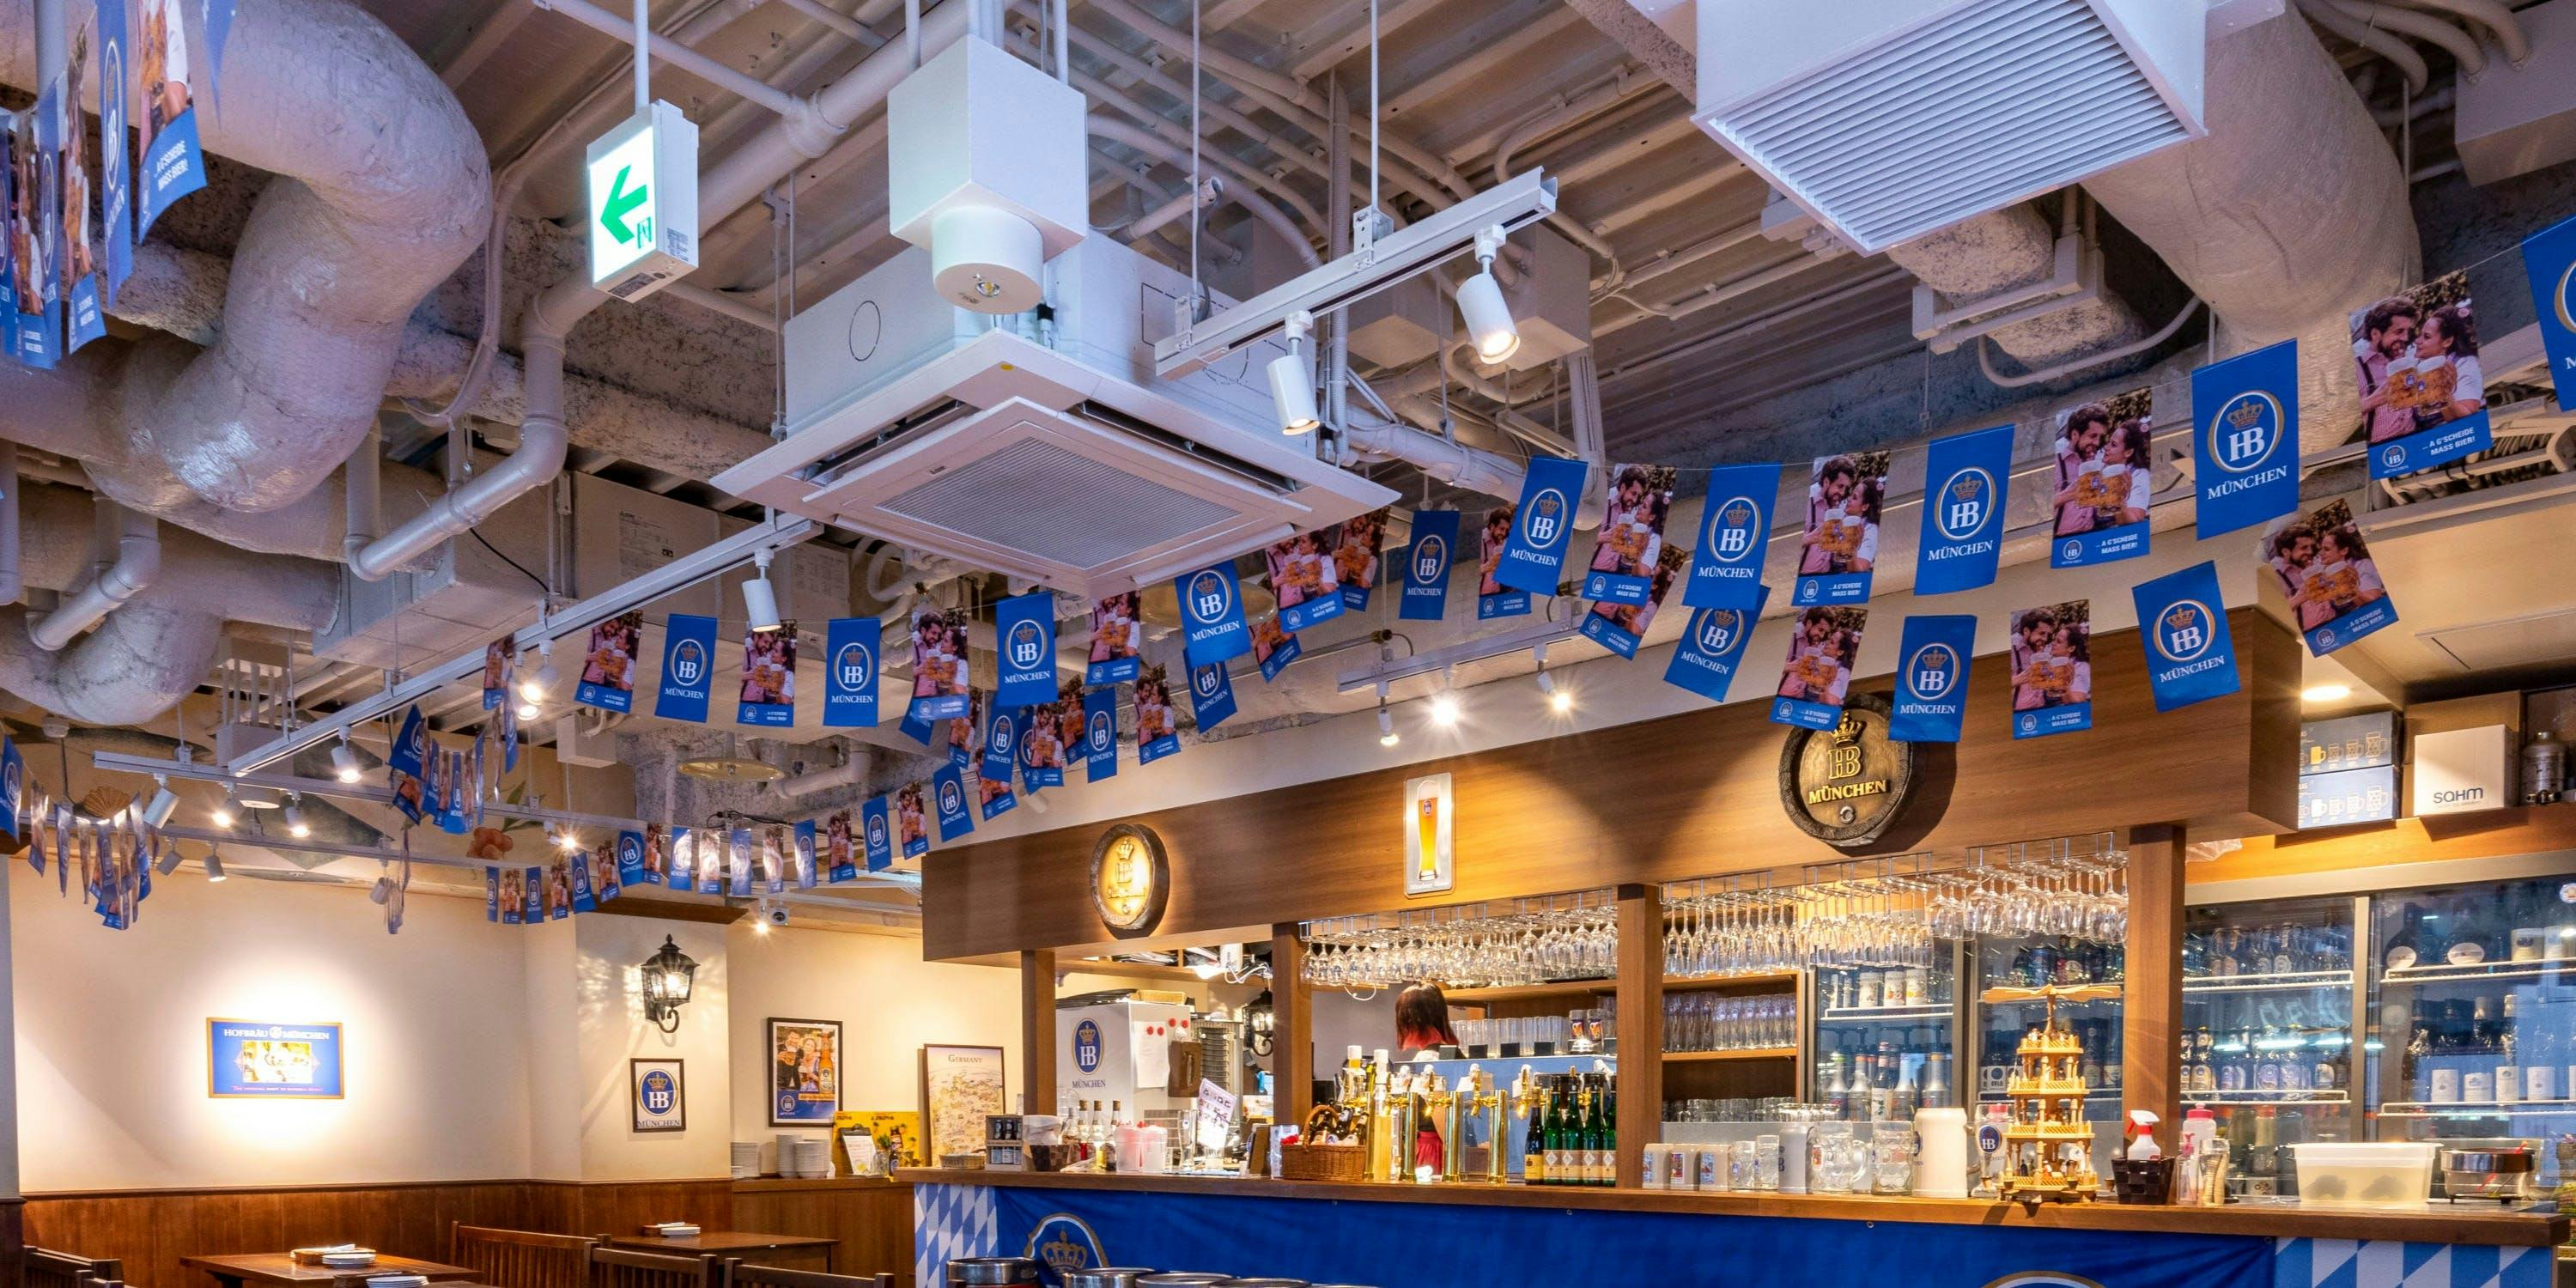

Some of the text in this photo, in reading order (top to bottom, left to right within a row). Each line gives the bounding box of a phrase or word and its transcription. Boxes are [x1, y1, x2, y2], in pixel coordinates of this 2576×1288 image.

[2228, 427, 2265, 462] HB
[2430, 435, 2476, 456] MASS BIER!
[2436, 427, 2475, 445] G'SCHEIDE
[2389, 454, 2402, 465] HB
[2207, 465, 2288, 500] MÜNCHEN
[1950, 501, 1979, 530] HB
[1532, 516, 1555, 539] HB
[1720, 528, 1746, 551] HB
[1510, 549, 1558, 567] MÜNCHEN
[1929, 540, 1994, 561] MÜNCHEN
[2068, 549, 2078, 557] HB
[1419, 558, 1437, 576] HB
[1698, 566, 1754, 578] MÜNCHEN
[1406, 587, 1443, 597] MÜNCHEN
[1200, 592, 1223, 617] HB
[1192, 620, 1241, 641] MÜNCHEN
[1704, 625, 1728, 649] HB
[2170, 625, 2202, 654] HB
[1017, 642, 1038, 663] HB
[678, 659, 696, 679] HB
[1680, 651, 1729, 675] MÜNCHEN
[2160, 655, 2226, 683] MÜNCHEN
[843, 665, 863, 683] HB
[1004, 671, 1051, 684] MÜNCHEN
[1201, 672, 1216, 692] HB
[1918, 671, 1945, 691] HB
[665, 687, 704, 699] MÜNCHEN
[831, 695, 873, 704] MÜNCHEN
[1198, 689, 1228, 713] MÜNCHEN
[1899, 703, 1956, 714] MÜNCHEN
[996, 732, 1007, 748] HB
[1095, 729, 1107, 745] HB
[1828, 745, 1862, 780] HB
[945, 795, 956, 809] HB
[1808, 780, 1887, 805] MÜNCHEN
[1080, 1045, 1097, 1066] HB
[1072, 1079, 1106, 1089] MÜNCHEN
[648, 1091, 669, 1109] HB
[636, 1119, 681, 1128] MÜNCHEN
[1982, 1138, 1996, 1150] HB
